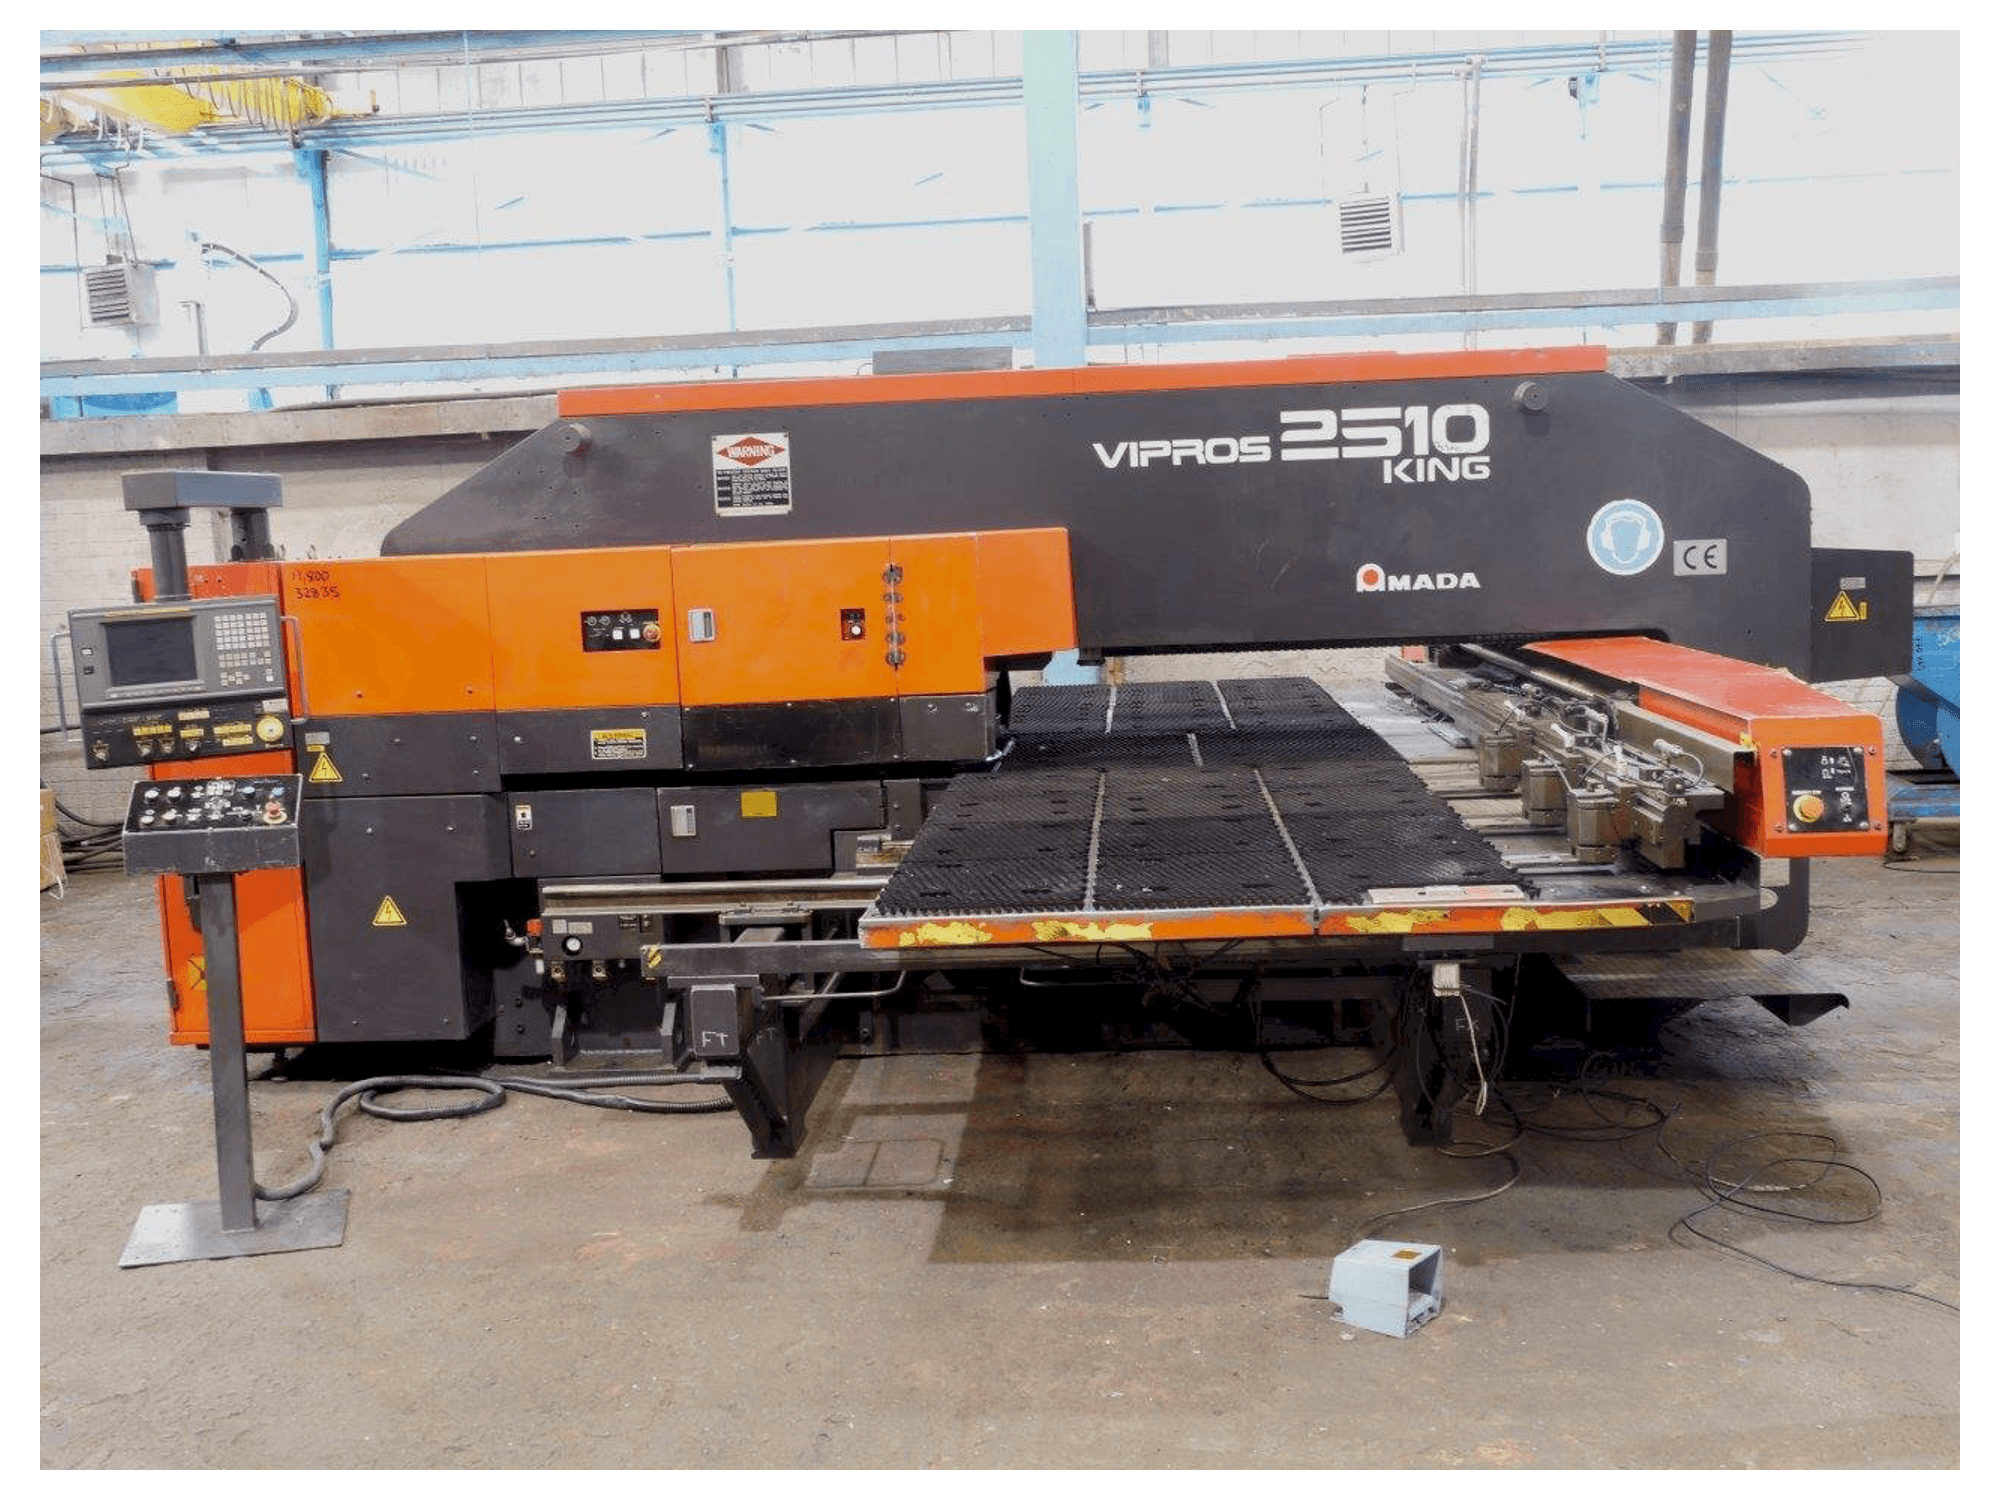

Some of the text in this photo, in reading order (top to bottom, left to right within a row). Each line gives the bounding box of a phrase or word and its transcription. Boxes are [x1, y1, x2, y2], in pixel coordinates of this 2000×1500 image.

[1092, 403, 1490, 469] VIPROS 2510
[727, 445, 776, 458] WARNING
[1383, 457, 1491, 484] KING
[1356, 563, 1481, 593] AMADA
[702, 1031, 729, 1048] FT
